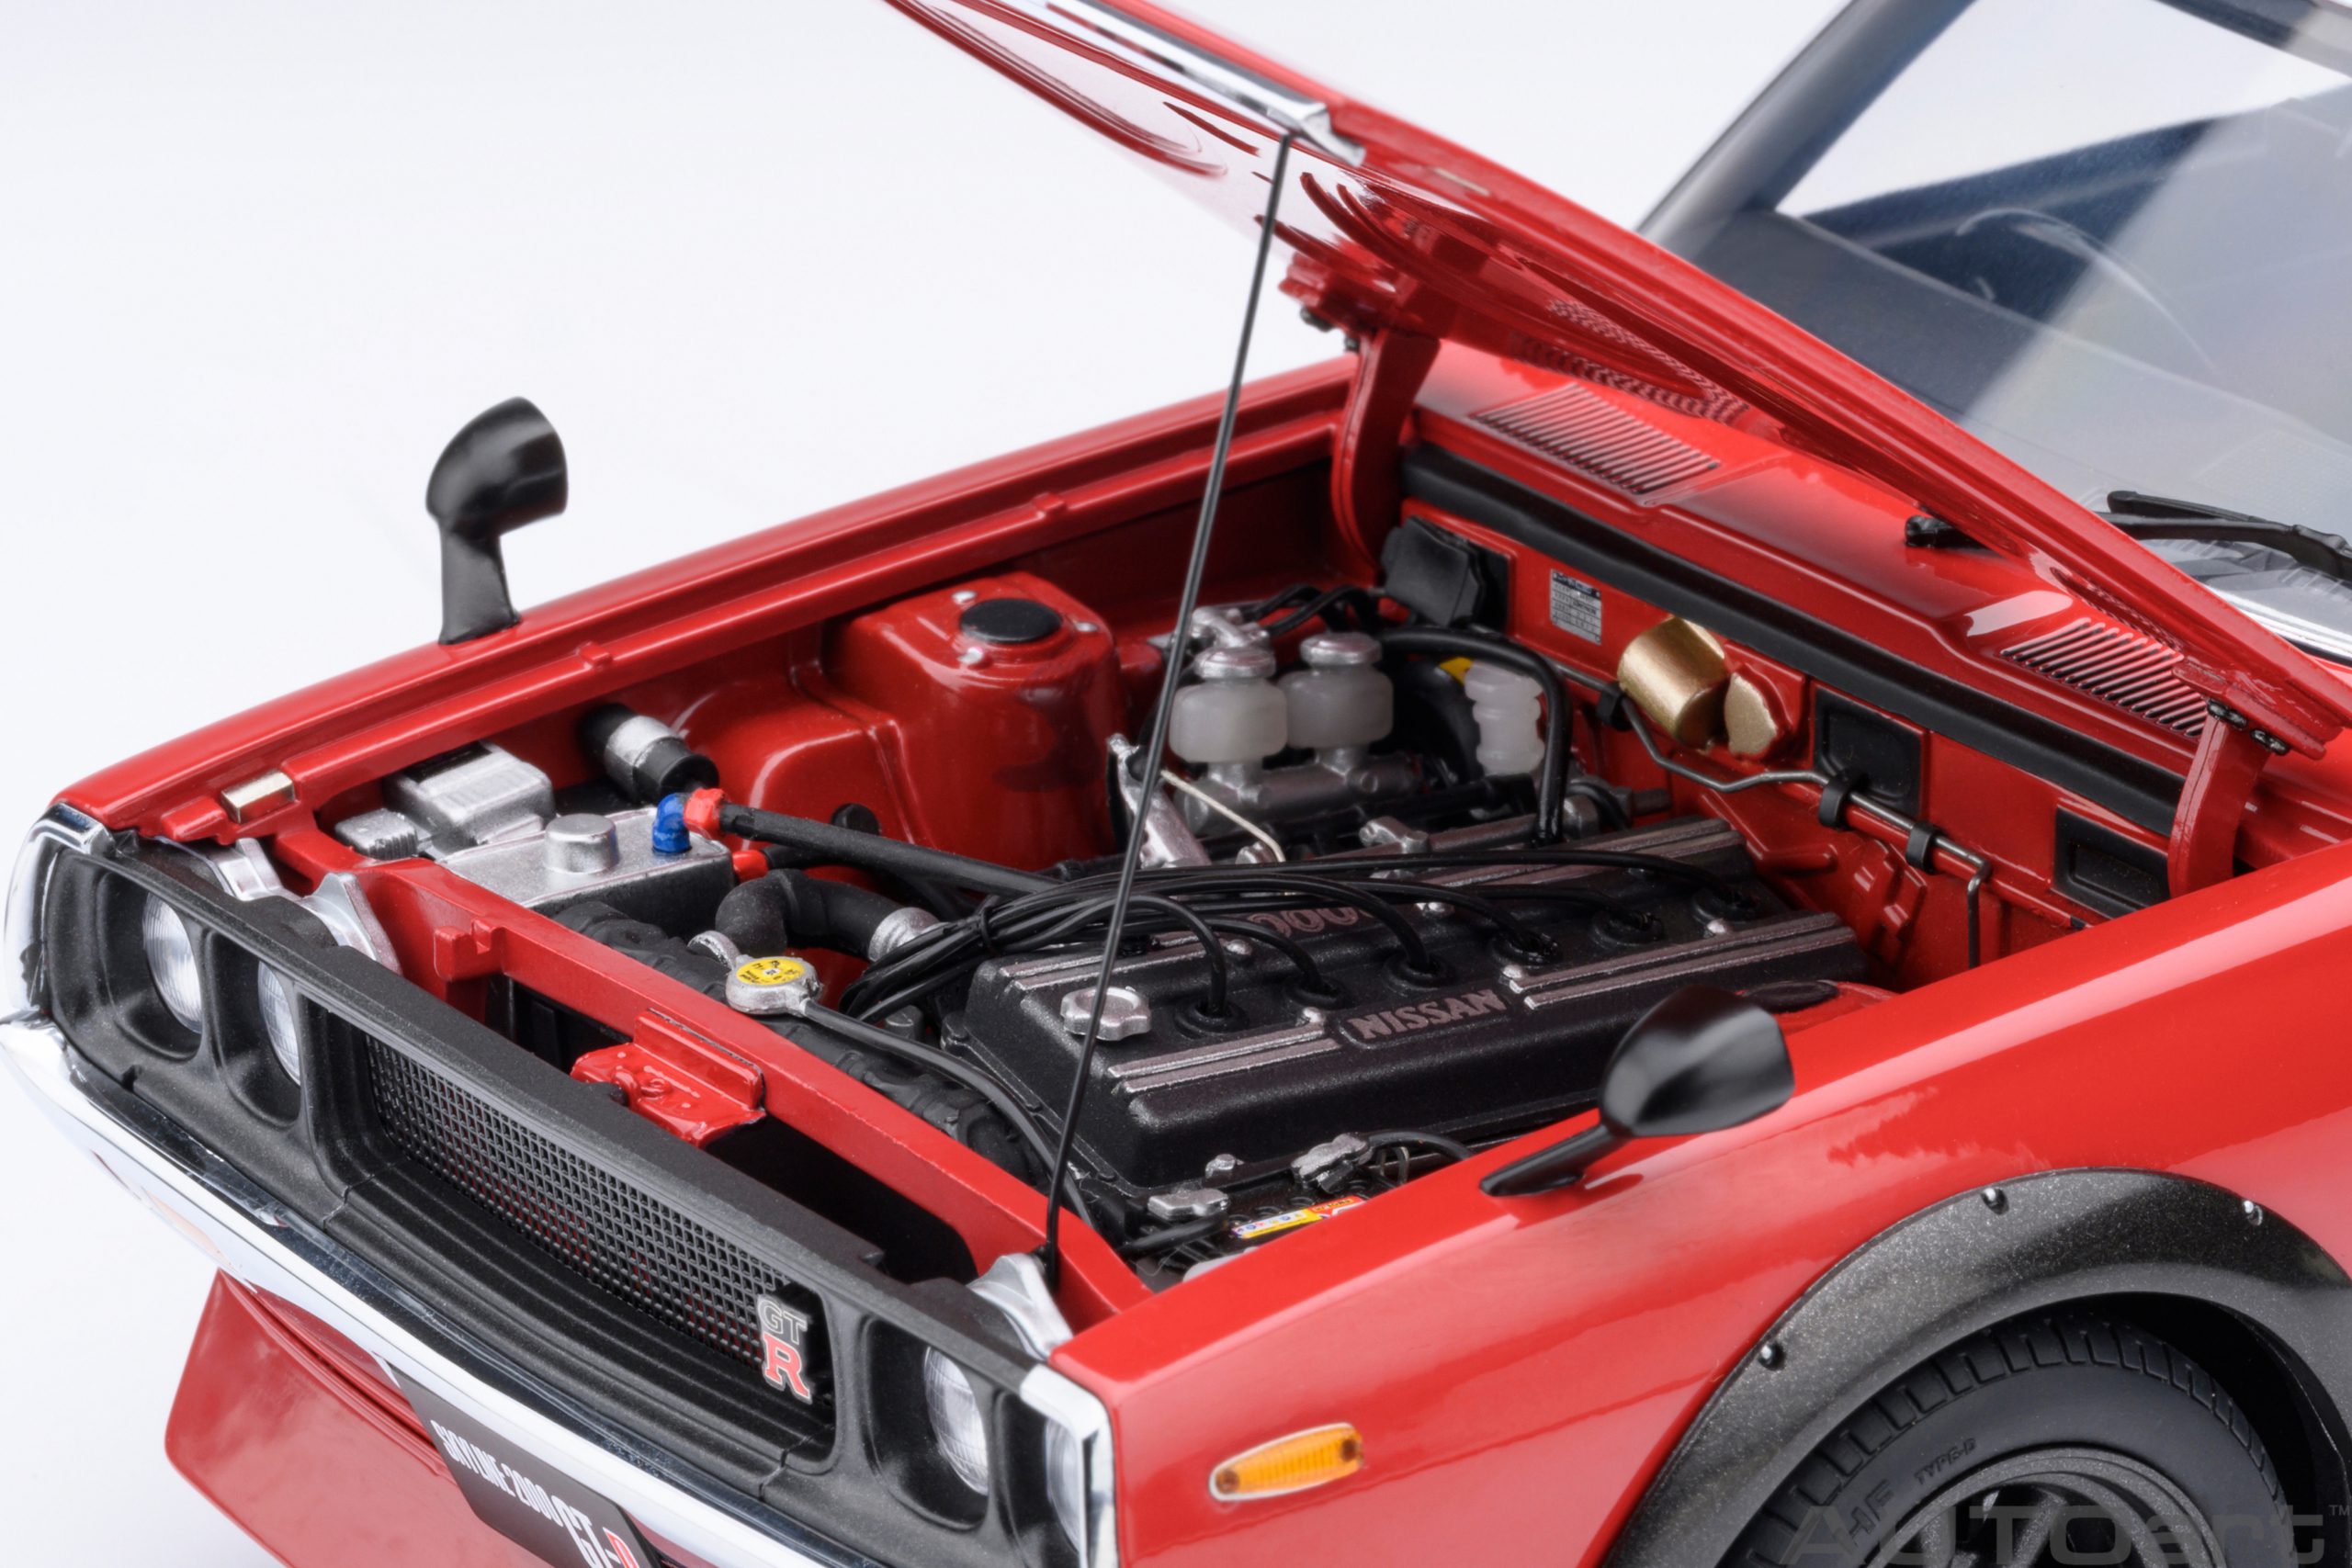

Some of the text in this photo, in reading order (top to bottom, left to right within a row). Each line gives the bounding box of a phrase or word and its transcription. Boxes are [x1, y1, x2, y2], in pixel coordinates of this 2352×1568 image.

[1348, 989, 1507, 1039] NISSAN
[758, 1298, 807, 1345] GT
[763, 1332, 810, 1400] R
